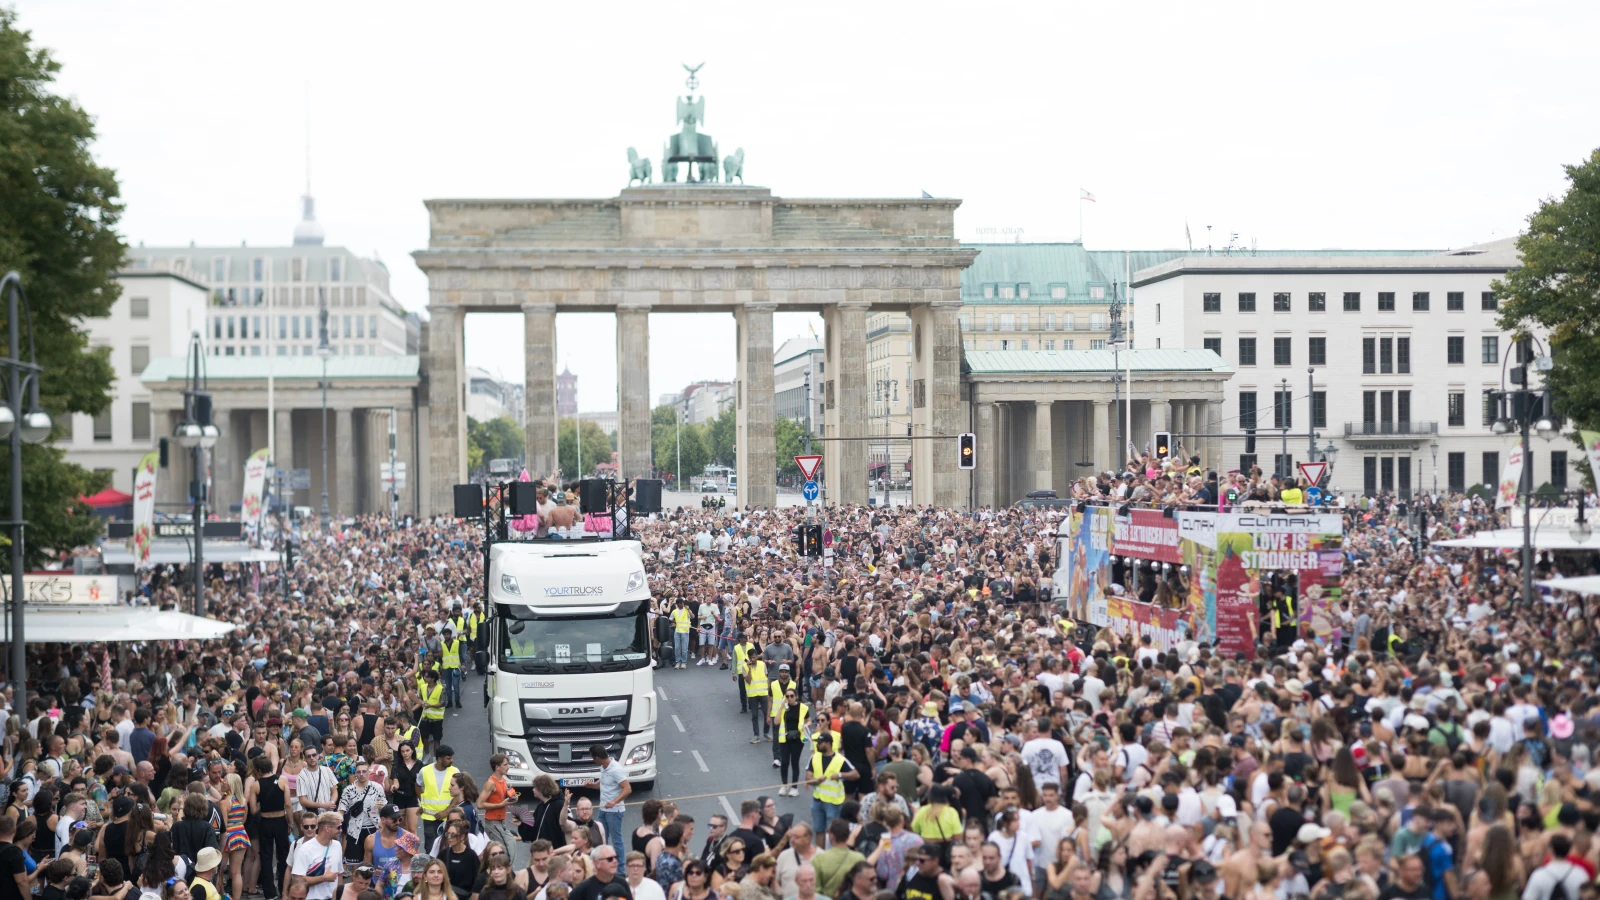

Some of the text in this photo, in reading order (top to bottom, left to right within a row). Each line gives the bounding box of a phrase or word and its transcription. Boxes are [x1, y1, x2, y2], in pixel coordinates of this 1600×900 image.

[1239, 518, 1321, 527] CLIMAX
[1253, 533, 1307, 551] LOVE IS
[1241, 551, 1319, 569] STRONGER
[543, 586, 604, 595] YOURTRUCKS
